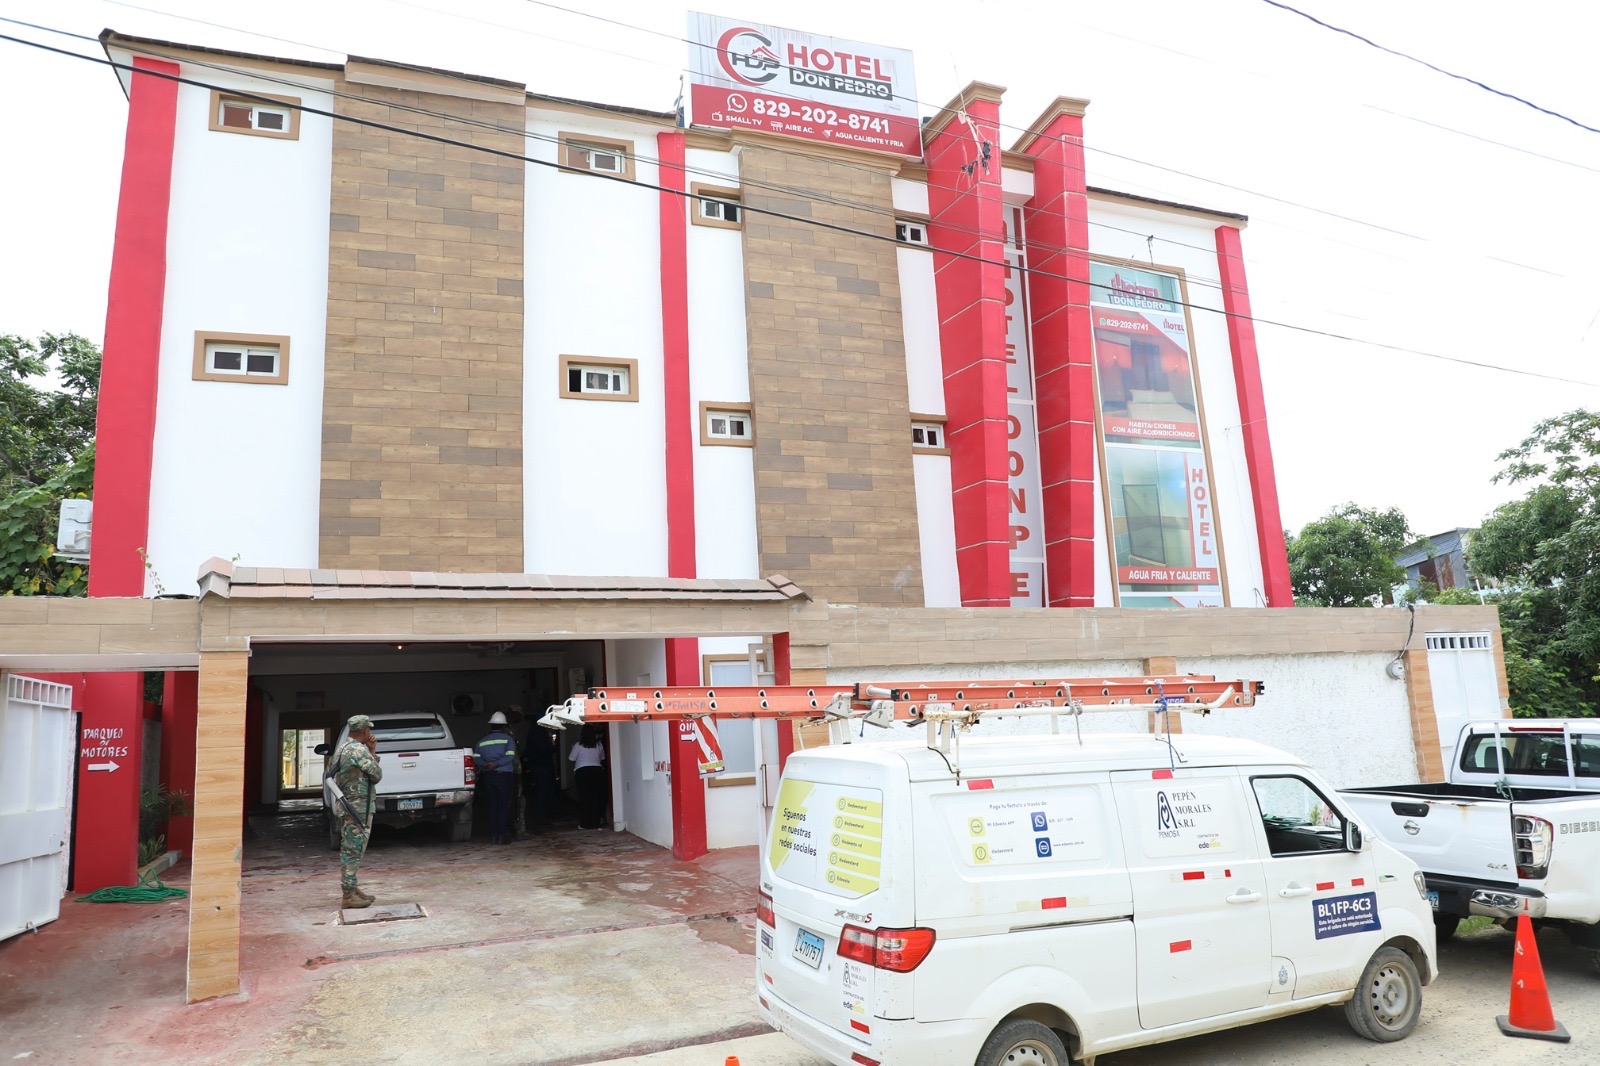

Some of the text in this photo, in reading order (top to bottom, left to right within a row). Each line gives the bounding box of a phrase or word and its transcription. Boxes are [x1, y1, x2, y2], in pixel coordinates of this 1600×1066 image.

[787, 42, 892, 82] HOTEL
[793, 69, 890, 98] DON PEDRO
[725, 114, 763, 126] SMALL TV
[753, 98, 890, 135] 829-202-8741
[785, 124, 800, 132] AIRE
[835, 131, 852, 140] AGUA
[853, 134, 884, 145] CALIENTE
[890, 139, 904, 148] FRIA
[1114, 296, 1165, 310] DON PEDRO
[1106, 318, 1149, 330] 829-202-8741
[1192, 468, 1212, 555] HOTEL
[1128, 570, 1211, 580] AGUA FRIA Y CALIENTE
[83, 728, 124, 740] PARQUEO
[81, 746, 128, 758] MOTORES
[1175, 804, 1212, 815] MORALES
[788, 826, 811, 838] nuestras
[1560, 821, 1600, 834] DIESEL
[779, 838, 817, 856] redes sociales
[1318, 898, 1371, 918] BL1FP-6C3
